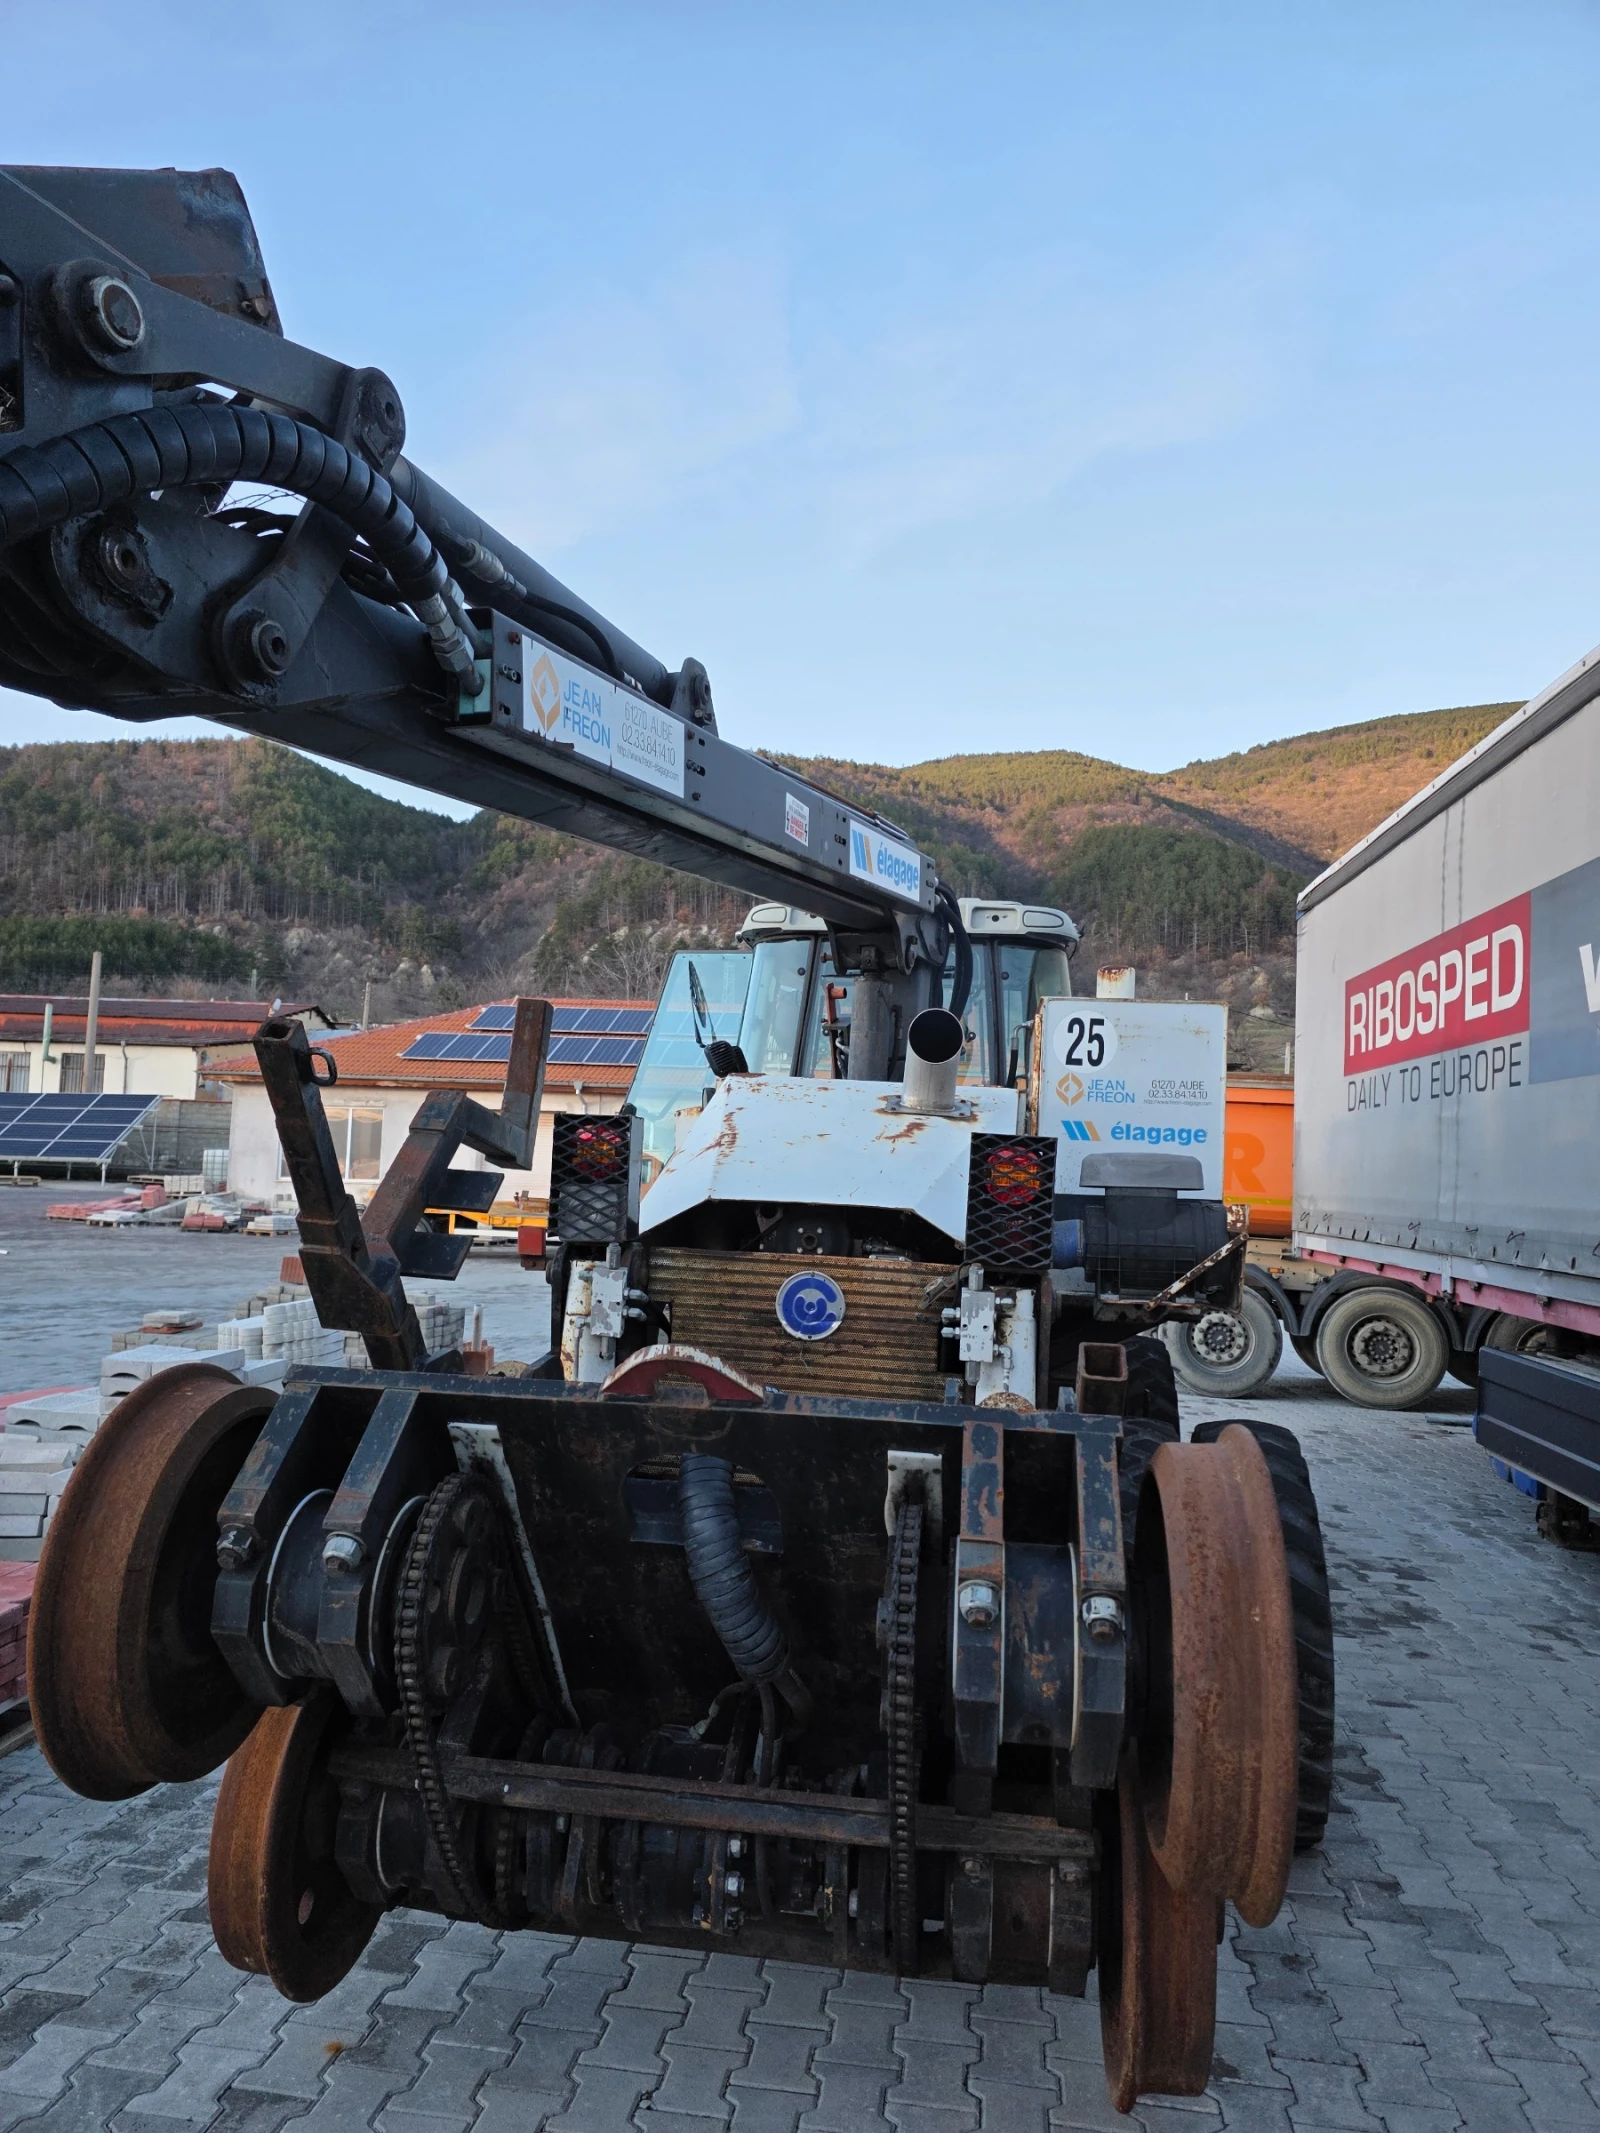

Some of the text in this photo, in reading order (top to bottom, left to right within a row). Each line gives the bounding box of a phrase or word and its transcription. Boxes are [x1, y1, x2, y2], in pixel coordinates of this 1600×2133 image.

[563, 680, 602, 718] JEAN
[563, 706, 611, 749] FREON
[624, 701, 673, 744] 61270 AUBE
[621, 723, 676, 766] 02.33.84.14.10
[877, 842, 919, 892] élagage
[1349, 924, 1524, 1057] RIBOSPED
[1065, 1017, 1105, 1067] 25
[1087, 1079, 1126, 1091] JEAN
[1087, 1091, 1136, 1104] FREON
[1148, 1090, 1208, 1100] 02.33.84.14.10
[1151, 1079, 1206, 1091] 61270 AUBE
[1347, 1042, 1522, 1112] DAILY TO EUROPE
[1110, 1121, 1208, 1147] élagage
